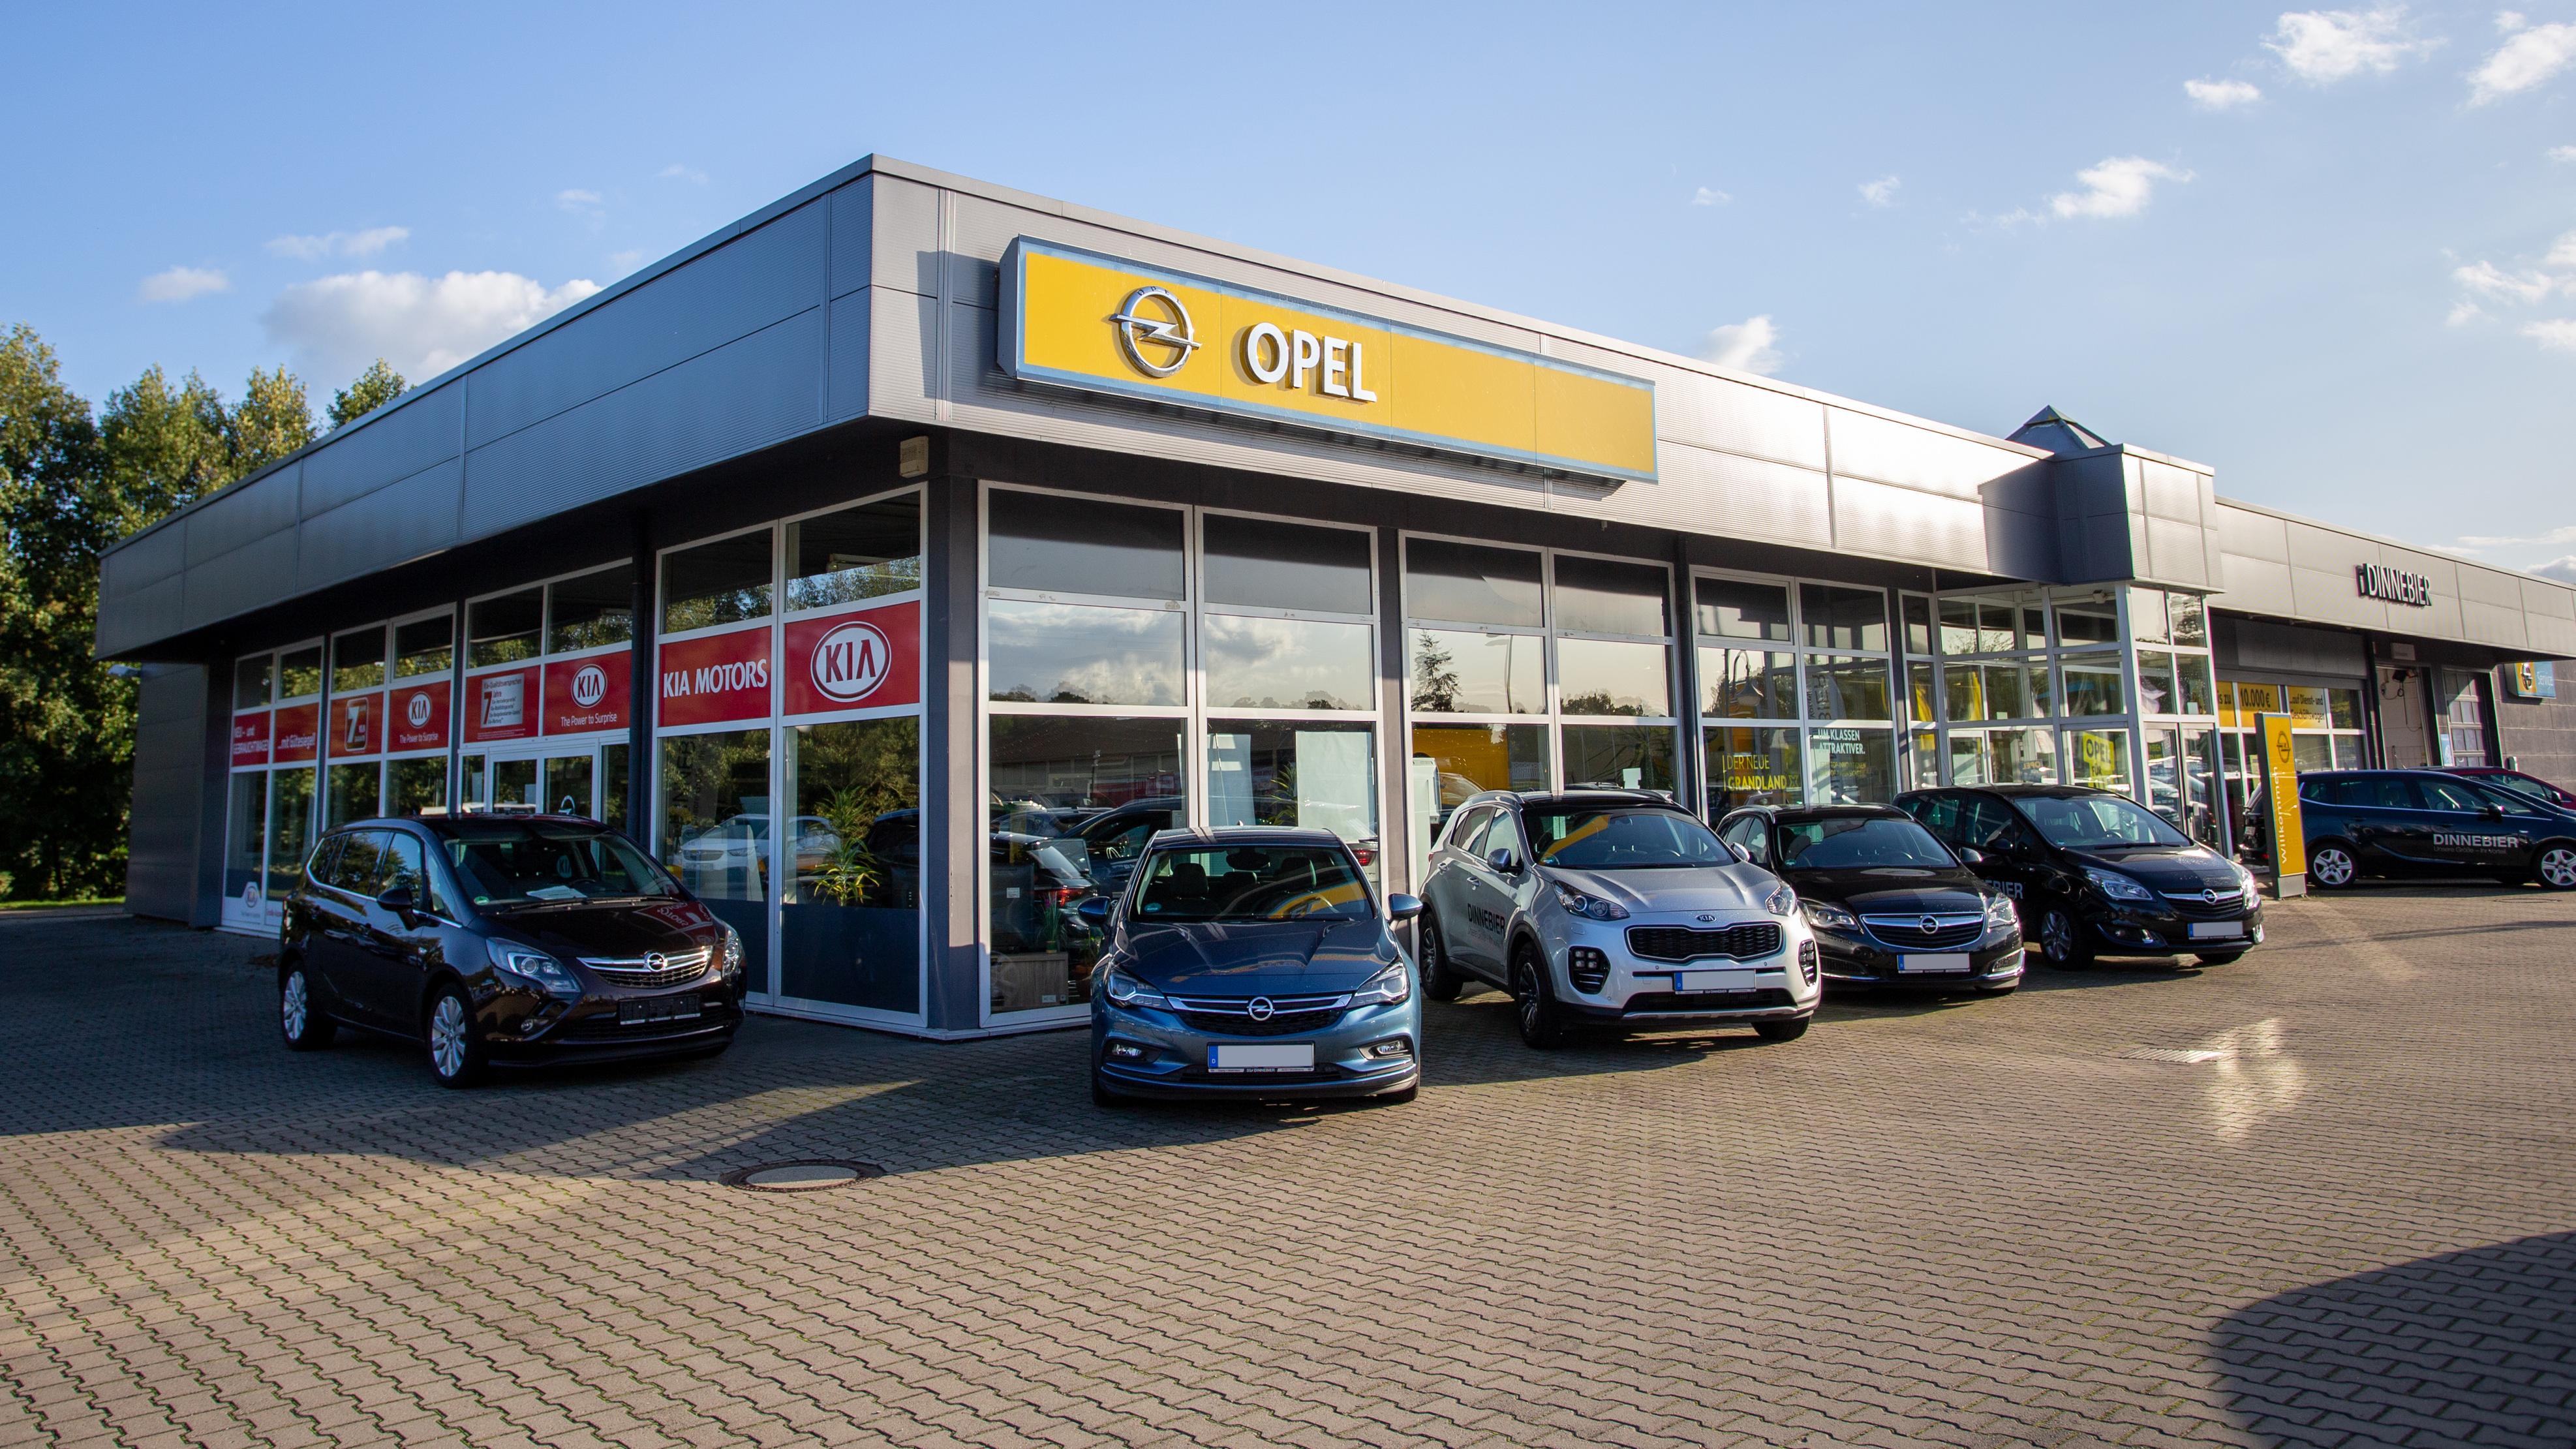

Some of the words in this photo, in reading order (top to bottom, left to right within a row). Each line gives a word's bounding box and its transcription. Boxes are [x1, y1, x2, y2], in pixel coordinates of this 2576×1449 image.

[1137, 286, 1182, 305] OPEL
[1246, 322, 1377, 403] OPEL
[2365, 564, 2432, 605] DINNEBIER
[825, 639, 876, 683] KIA
[577, 674, 600, 698] KIA
[663, 670, 690, 698] KIA
[695, 659, 768, 695] MOTORS
[2224, 694, 2231, 705] zu
[411, 700, 427, 720] KIA
[561, 716, 570, 727] The
[571, 715, 587, 725] Power
[588, 714, 594, 724] to
[595, 712, 617, 725] Surprise
[406, 734, 418, 743] Power
[423, 732, 438, 743] Surprise
[1830, 729, 1860, 741] KLASSEN
[1818, 742, 1865, 754] ATTRAKTIVER.
[2086, 739, 2111, 764] OPEL
[1726, 755, 1744, 770] DER
[1746, 755, 1770, 770] NEUE
[1728, 774, 1787, 791] GRANDLAND
[2433, 834, 2519, 848] DINNEBIER
[1467, 903, 1506, 938] DINNEBIER
